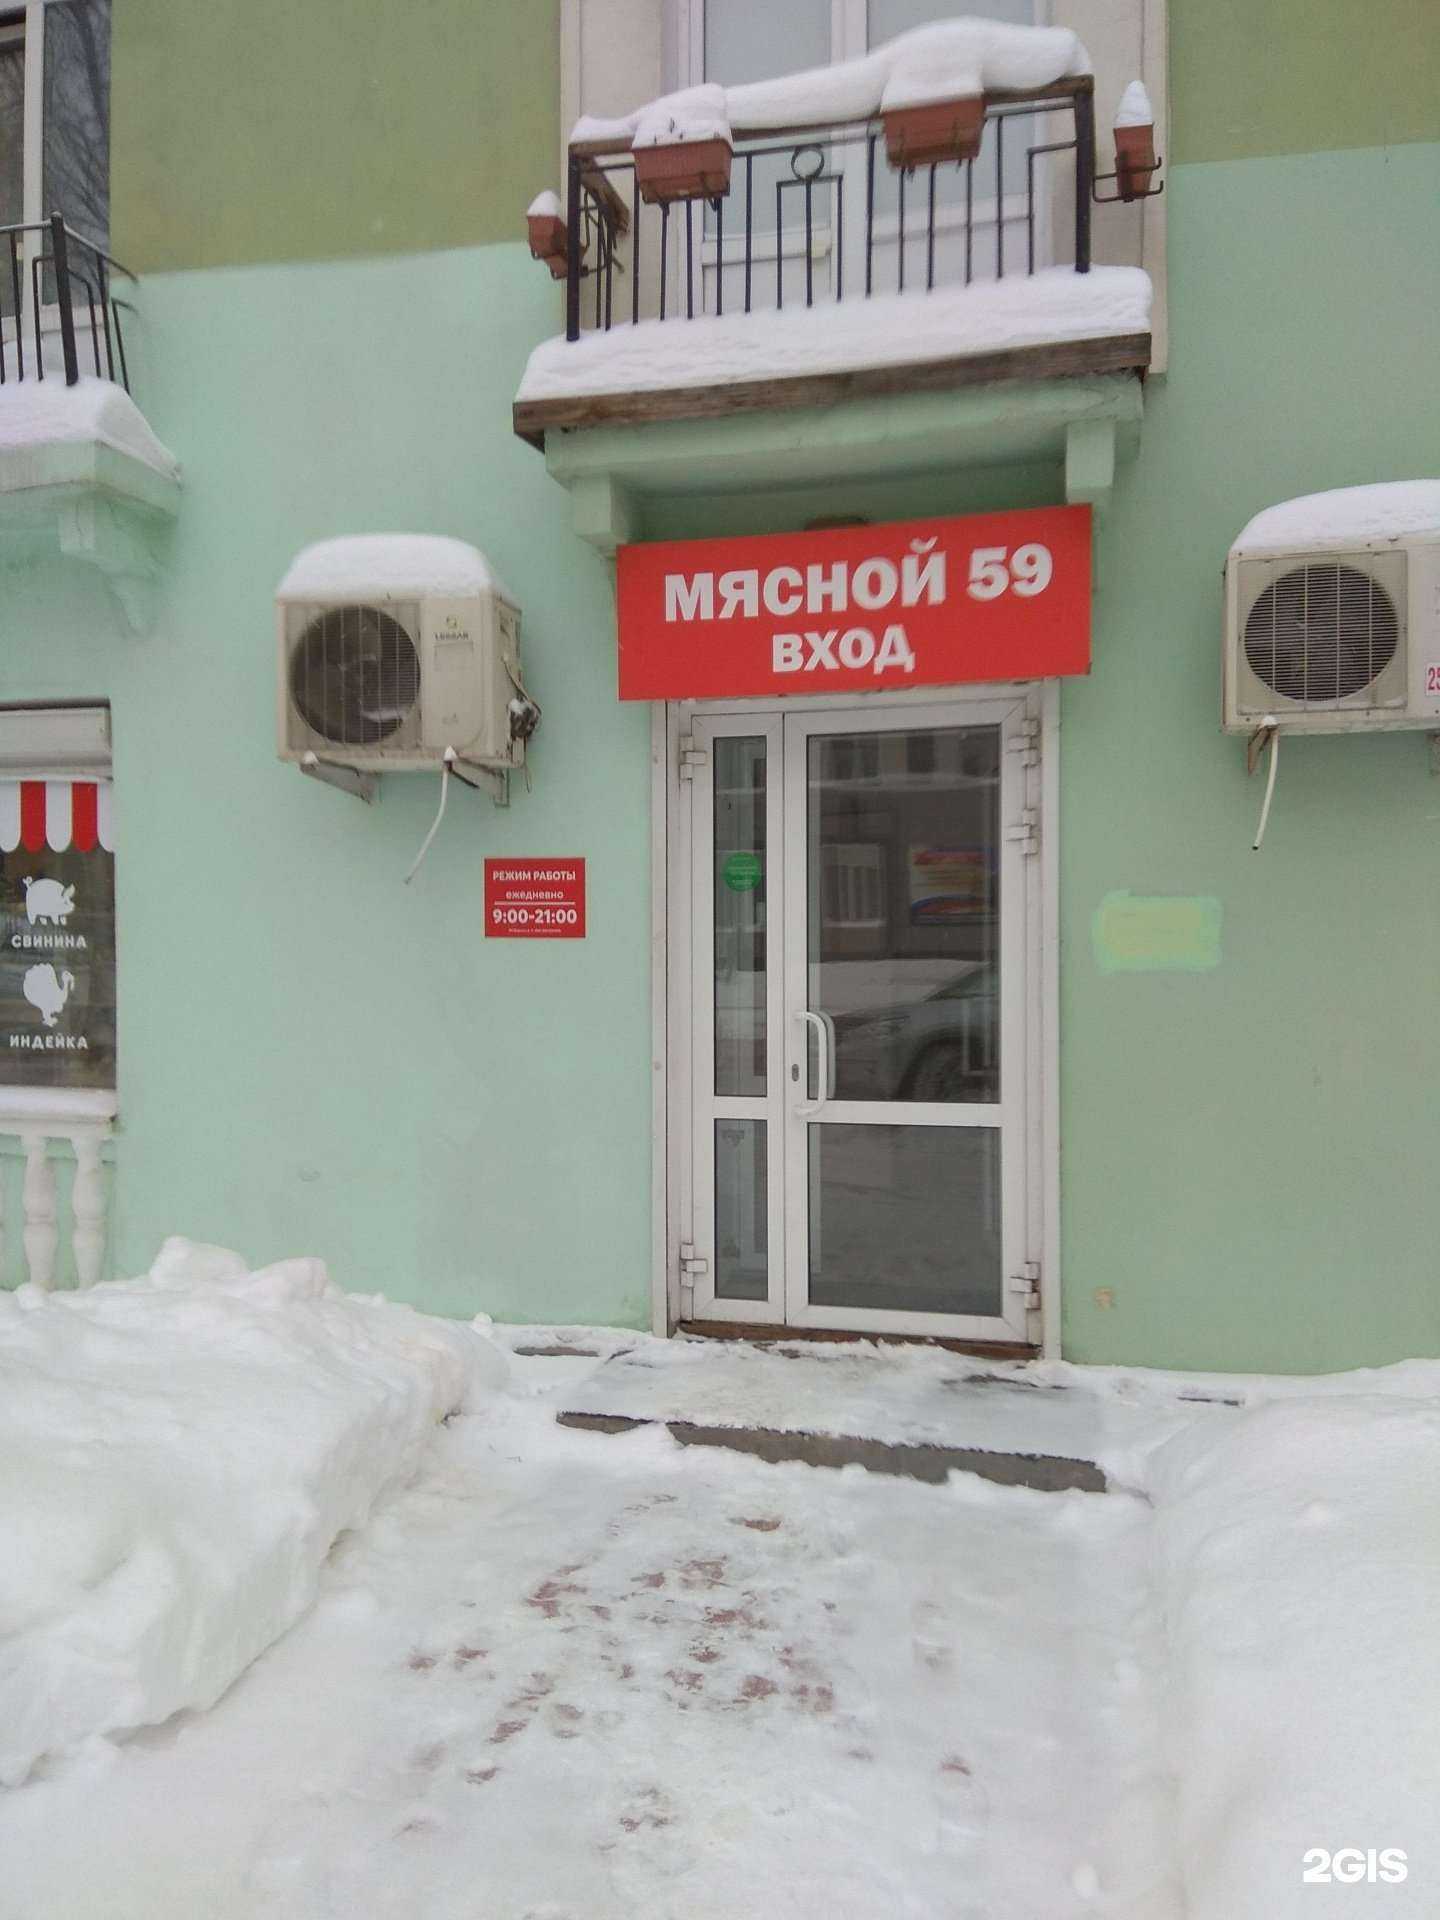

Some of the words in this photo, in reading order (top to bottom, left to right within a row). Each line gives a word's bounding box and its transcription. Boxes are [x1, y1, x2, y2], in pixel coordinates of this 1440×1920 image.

[664, 536, 946, 623] МЯСНОЙ
[967, 543, 1054, 602] 59
[771, 623, 916, 675] ВХОД
[493, 870, 531, 881] РЕЖИМ
[533, 870, 576, 881] РАБОТЫ
[492, 908, 577, 924] 9:00-21:00
[11, 934, 87, 949] СВИНИНА
[9, 1033, 89, 1050] ИНДЕЙКА
